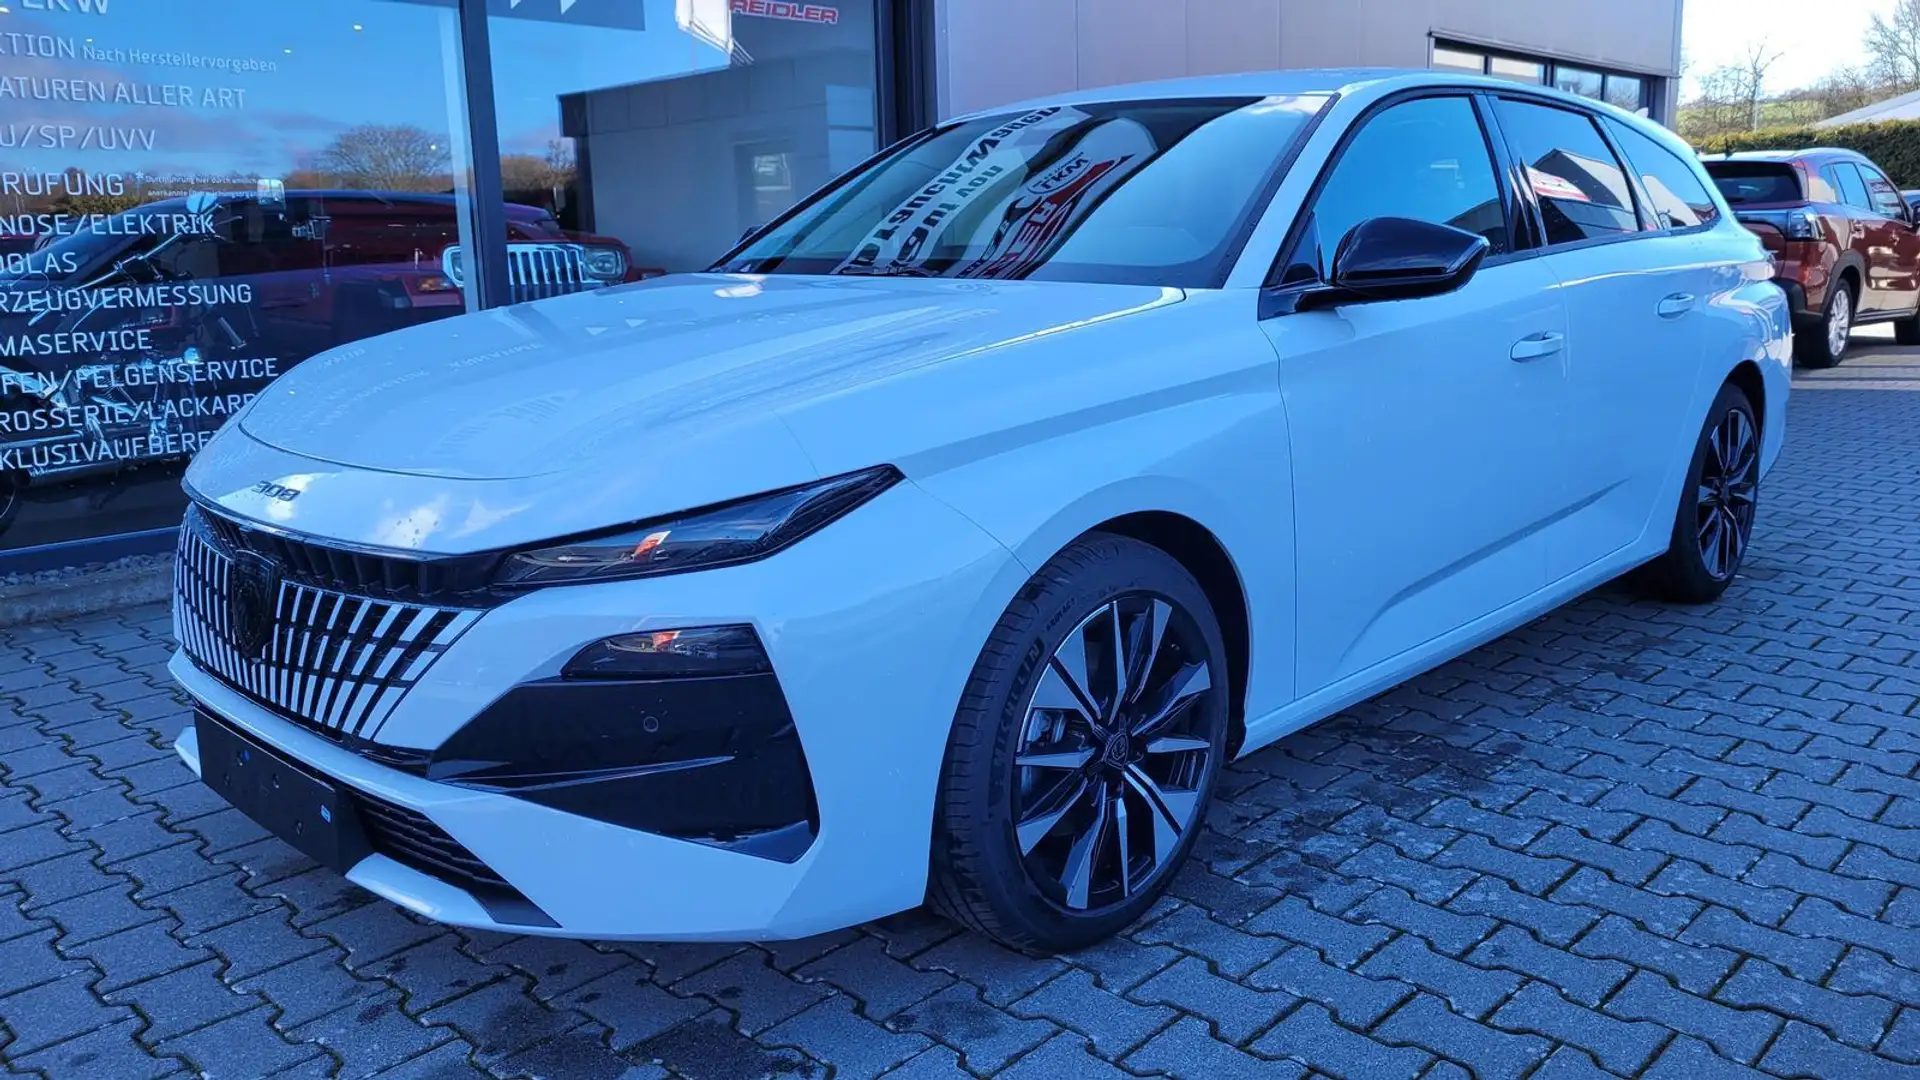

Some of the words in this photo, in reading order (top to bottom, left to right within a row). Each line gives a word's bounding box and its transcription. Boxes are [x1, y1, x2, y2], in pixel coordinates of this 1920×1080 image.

[0, 32, 75, 58] TION
[83, 44, 124, 62] Nach
[130, 49, 276, 73] Herstellervorgaben
[0, 76, 105, 102] ATUREN
[115, 82, 193, 106] ALLER
[202, 88, 246, 109] ART
[4, 167, 124, 196] RÜFUNG
[0, 213, 216, 236] NOSE/ELEKTRIK
[251, 480, 301, 502] 308
